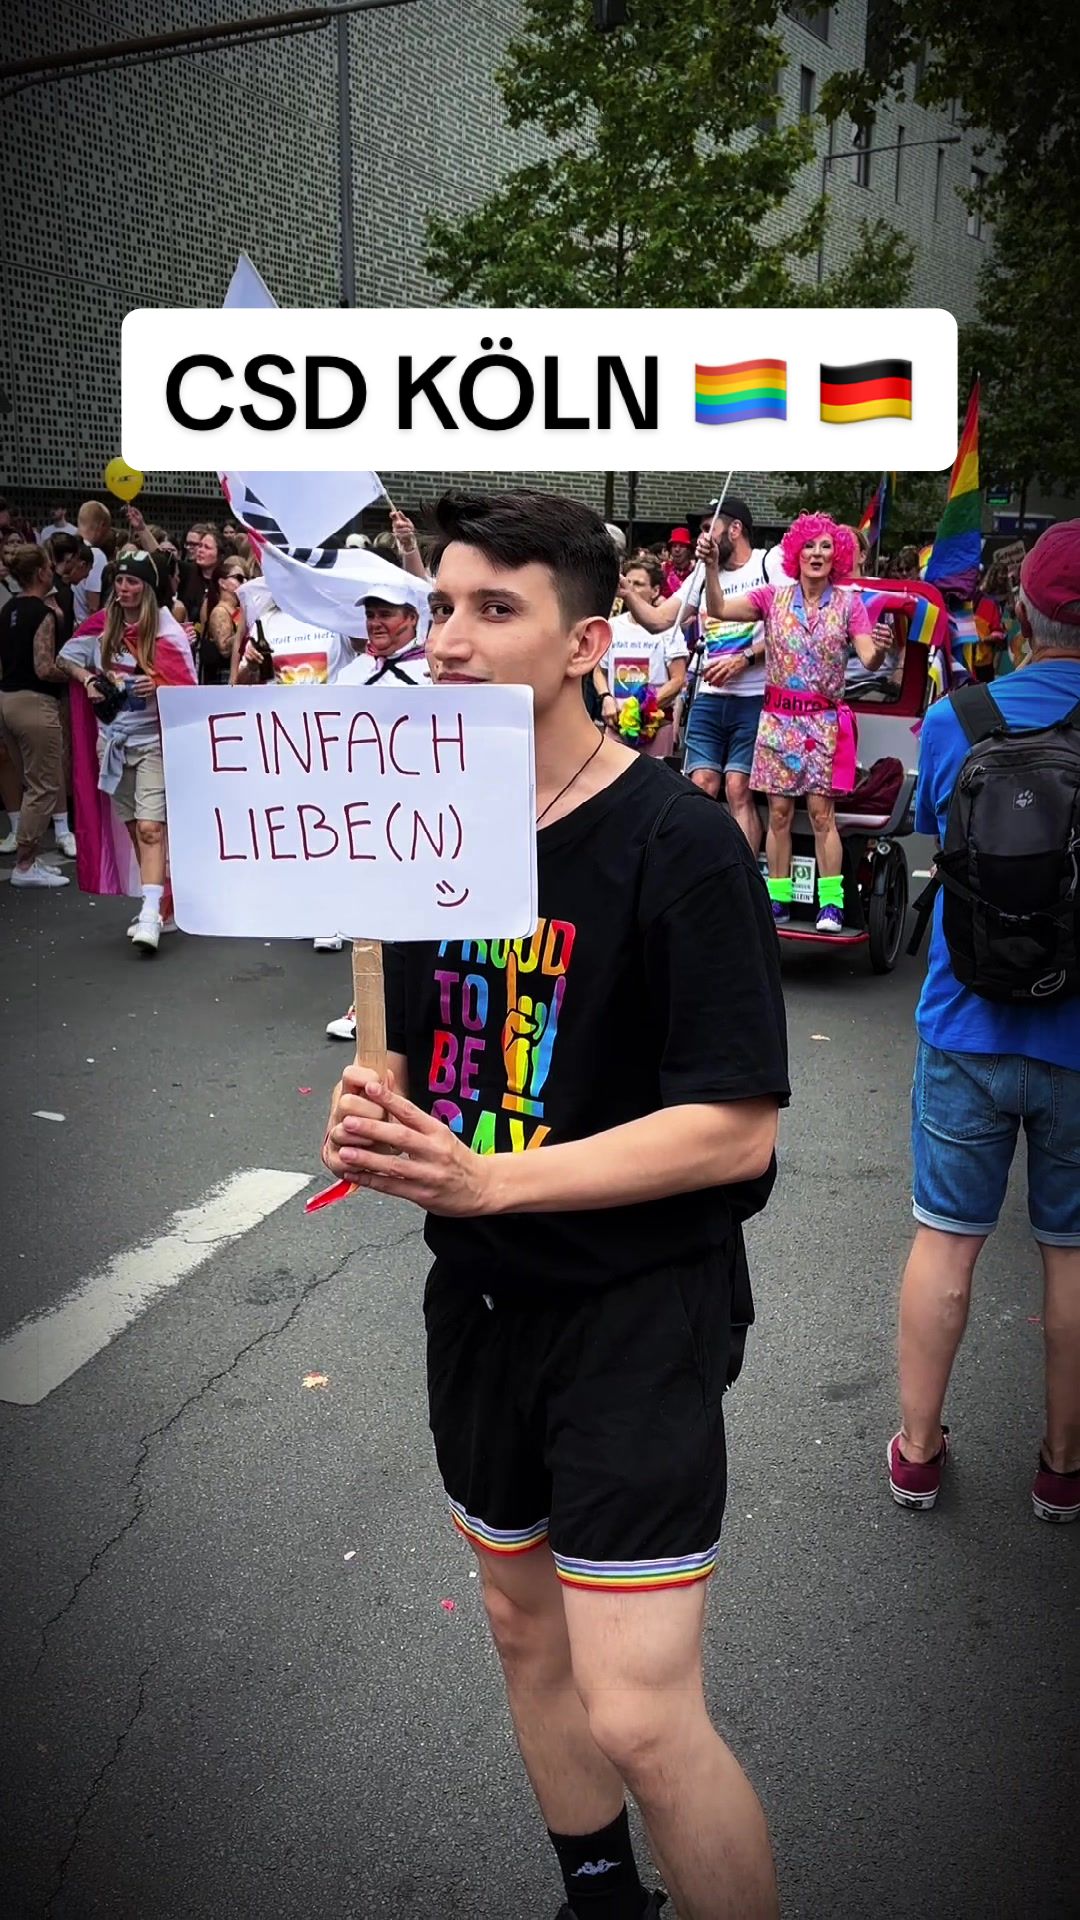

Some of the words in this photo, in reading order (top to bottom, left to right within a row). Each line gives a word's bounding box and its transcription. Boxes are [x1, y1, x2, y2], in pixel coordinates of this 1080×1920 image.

[208, 710, 467, 775] EINFACH
[214, 801, 464, 862] LIEBE(N)
[433, 969, 489, 1032] TO
[428, 1029, 487, 1101] BE
